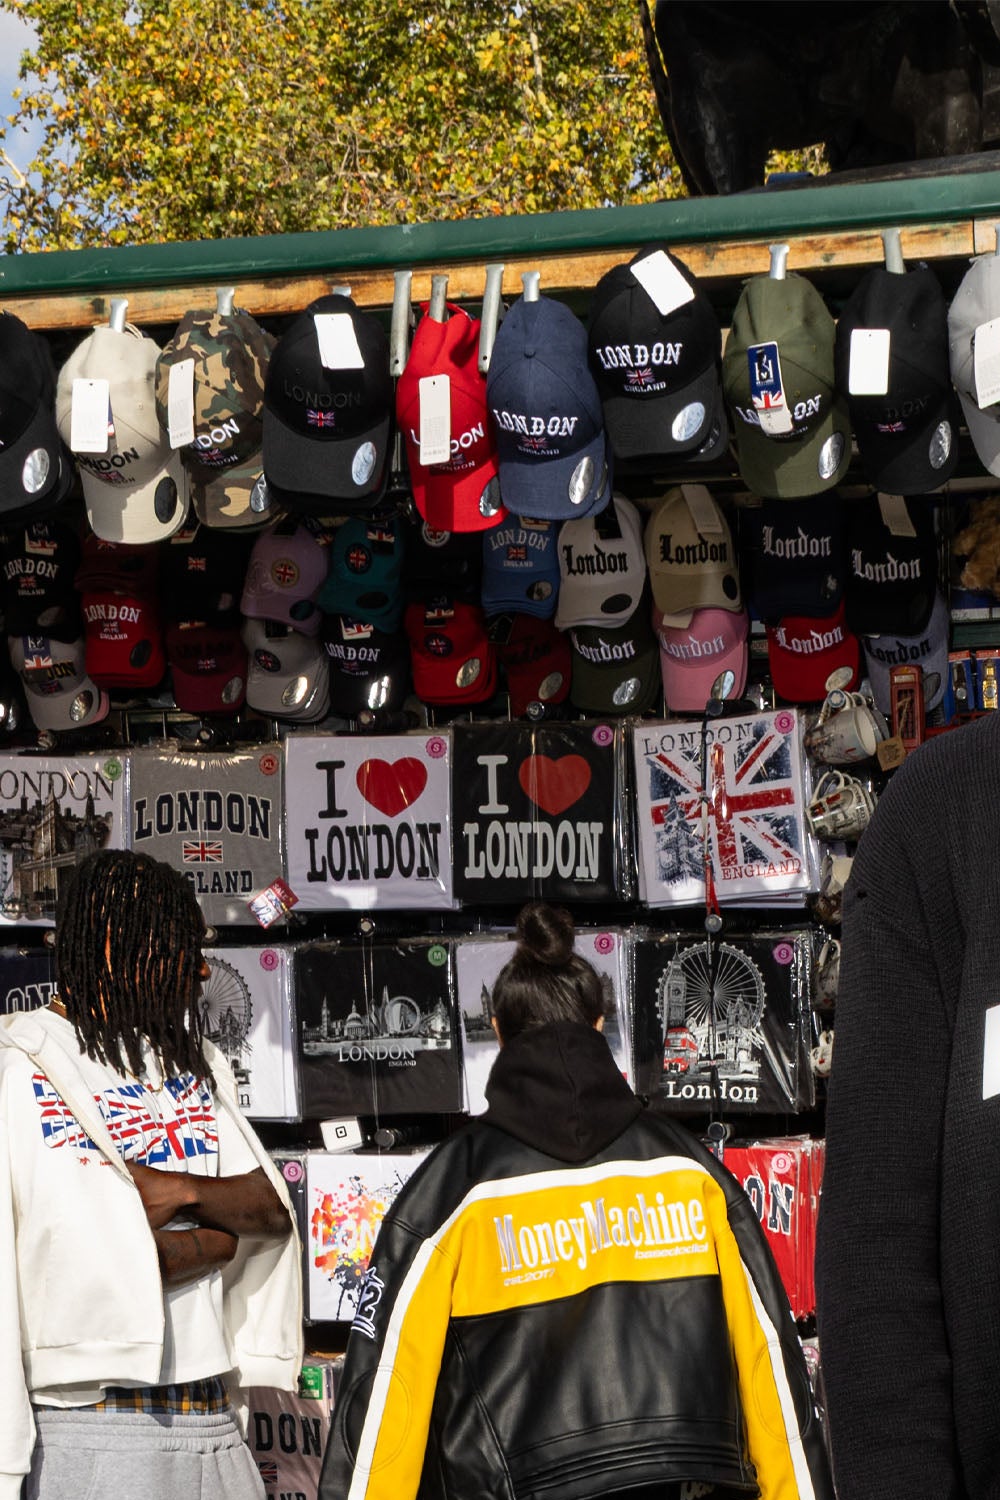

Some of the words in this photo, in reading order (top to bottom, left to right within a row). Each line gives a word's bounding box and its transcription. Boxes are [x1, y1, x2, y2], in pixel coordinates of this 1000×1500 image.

[596, 342, 683, 370] LONDON
[624, 380, 667, 392] ENGLAND
[493, 408, 578, 437] LONDON
[488, 529, 551, 552] LONDON
[659, 534, 728, 565] London
[762, 525, 832, 560] London
[3, 557, 60, 581] LONDON
[563, 543, 628, 576] London
[852, 548, 922, 584] London
[84, 603, 142, 625] LONDON
[324, 641, 381, 663] LONDON
[571, 628, 636, 663] London
[656, 629, 726, 660] London
[776, 626, 845, 655] London
[599, 729, 609, 742] S
[643, 722, 754, 757] LONDON
[0, 770, 114, 801] ONDON
[316, 760, 348, 819] I
[477, 754, 508, 815] I
[134, 790, 272, 842] LONDON
[304, 822, 442, 883] LONDON
[463, 819, 604, 880] LONDON
[721, 858, 802, 881] ENGLAND
[433, 951, 442, 961] M
[600, 936, 609, 949] S
[338, 1044, 416, 1064] LONDON
[388, 1059, 417, 1068] ENGLAND
[666, 1080, 760, 1104] London
[253, 1411, 322, 1458] DON
